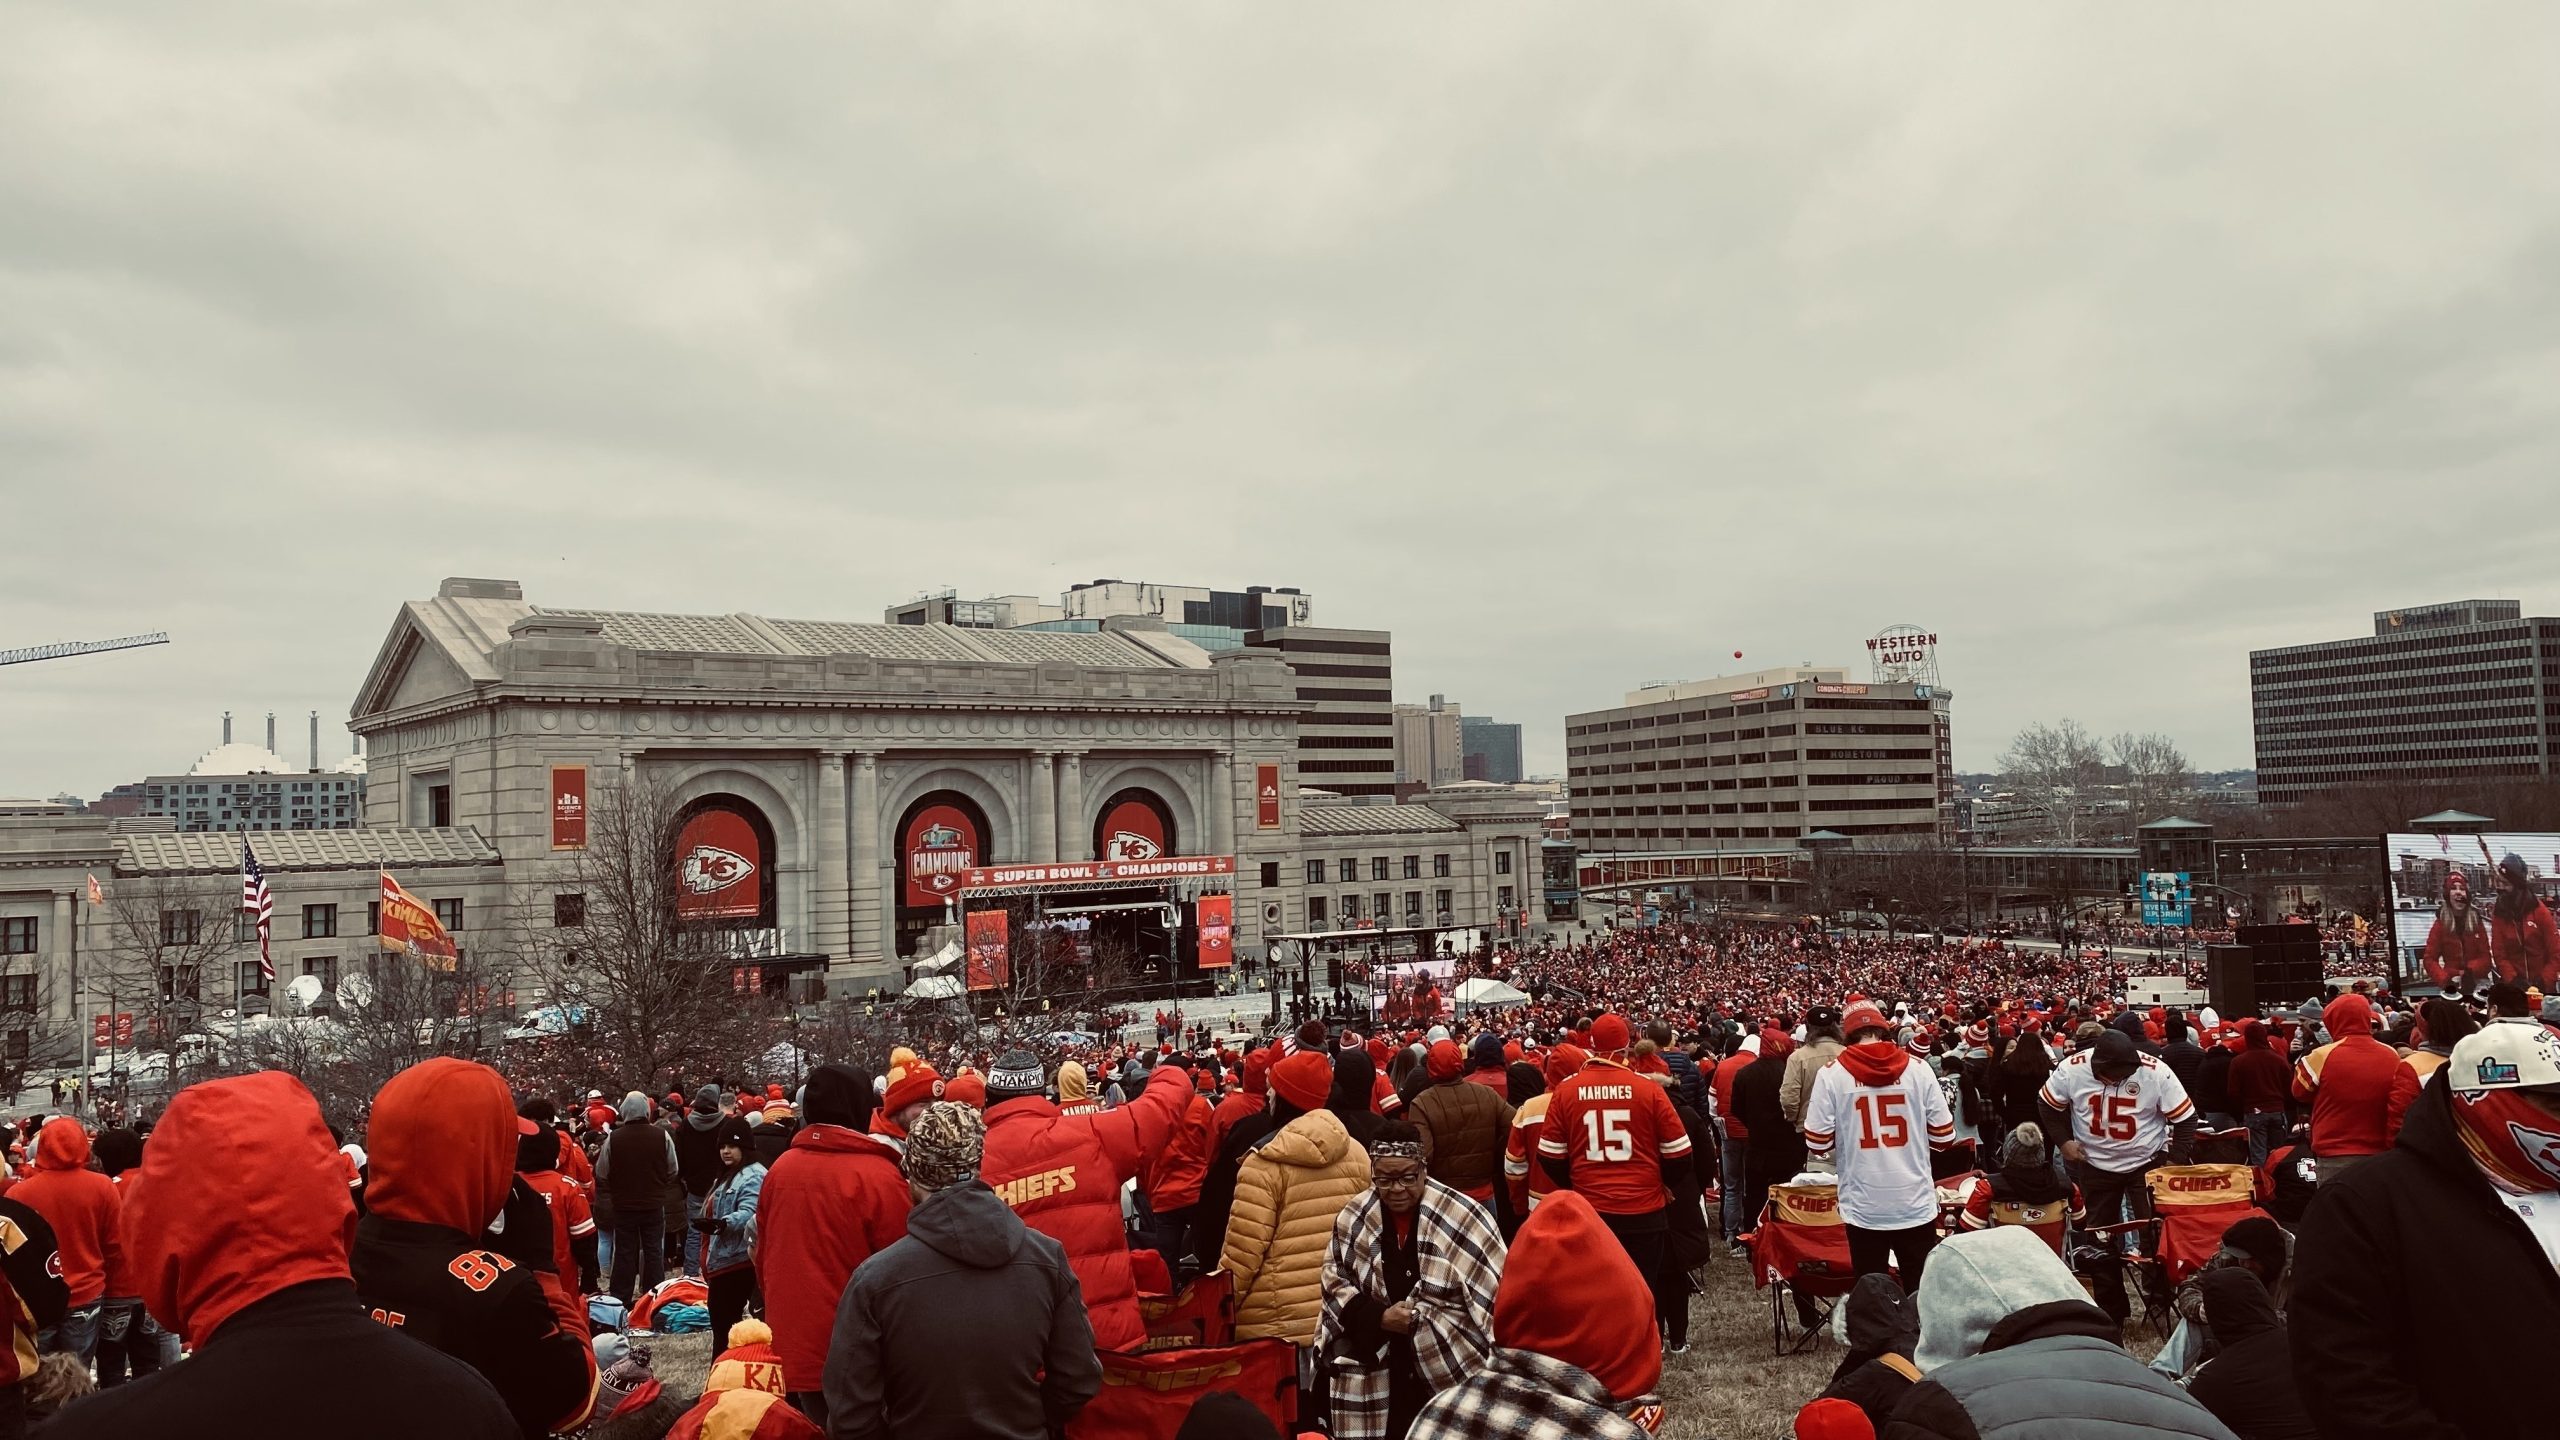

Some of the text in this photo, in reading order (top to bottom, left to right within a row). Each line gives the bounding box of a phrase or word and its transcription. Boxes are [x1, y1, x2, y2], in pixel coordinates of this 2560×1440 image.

[1865, 633, 1937, 650] WESTERN
[1882, 650, 1923, 664] AUTO
[1815, 725, 1865, 733] BLUE KC
[1830, 750, 1886, 759] HOMETOWN
[1866, 775, 1900, 783] PROUD
[913, 851, 971, 877] CHAMPIONS
[993, 868, 1046, 882] SUPER
[1049, 866, 1093, 879] BOWL
[1117, 861, 1208, 875] CHAMPIONS
[1578, 1085, 1632, 1100] MAHOMES
[1854, 1093, 1909, 1149] 15
[2088, 1093, 2137, 1141] 15
[1583, 1109, 1633, 1162] 15
[993, 1165, 1077, 1207] HIEFS
[2167, 1174, 2232, 1192] CHIEFS
[448, 1249, 517, 1292] 87
[1142, 1335, 1194, 1350] HIEFS
